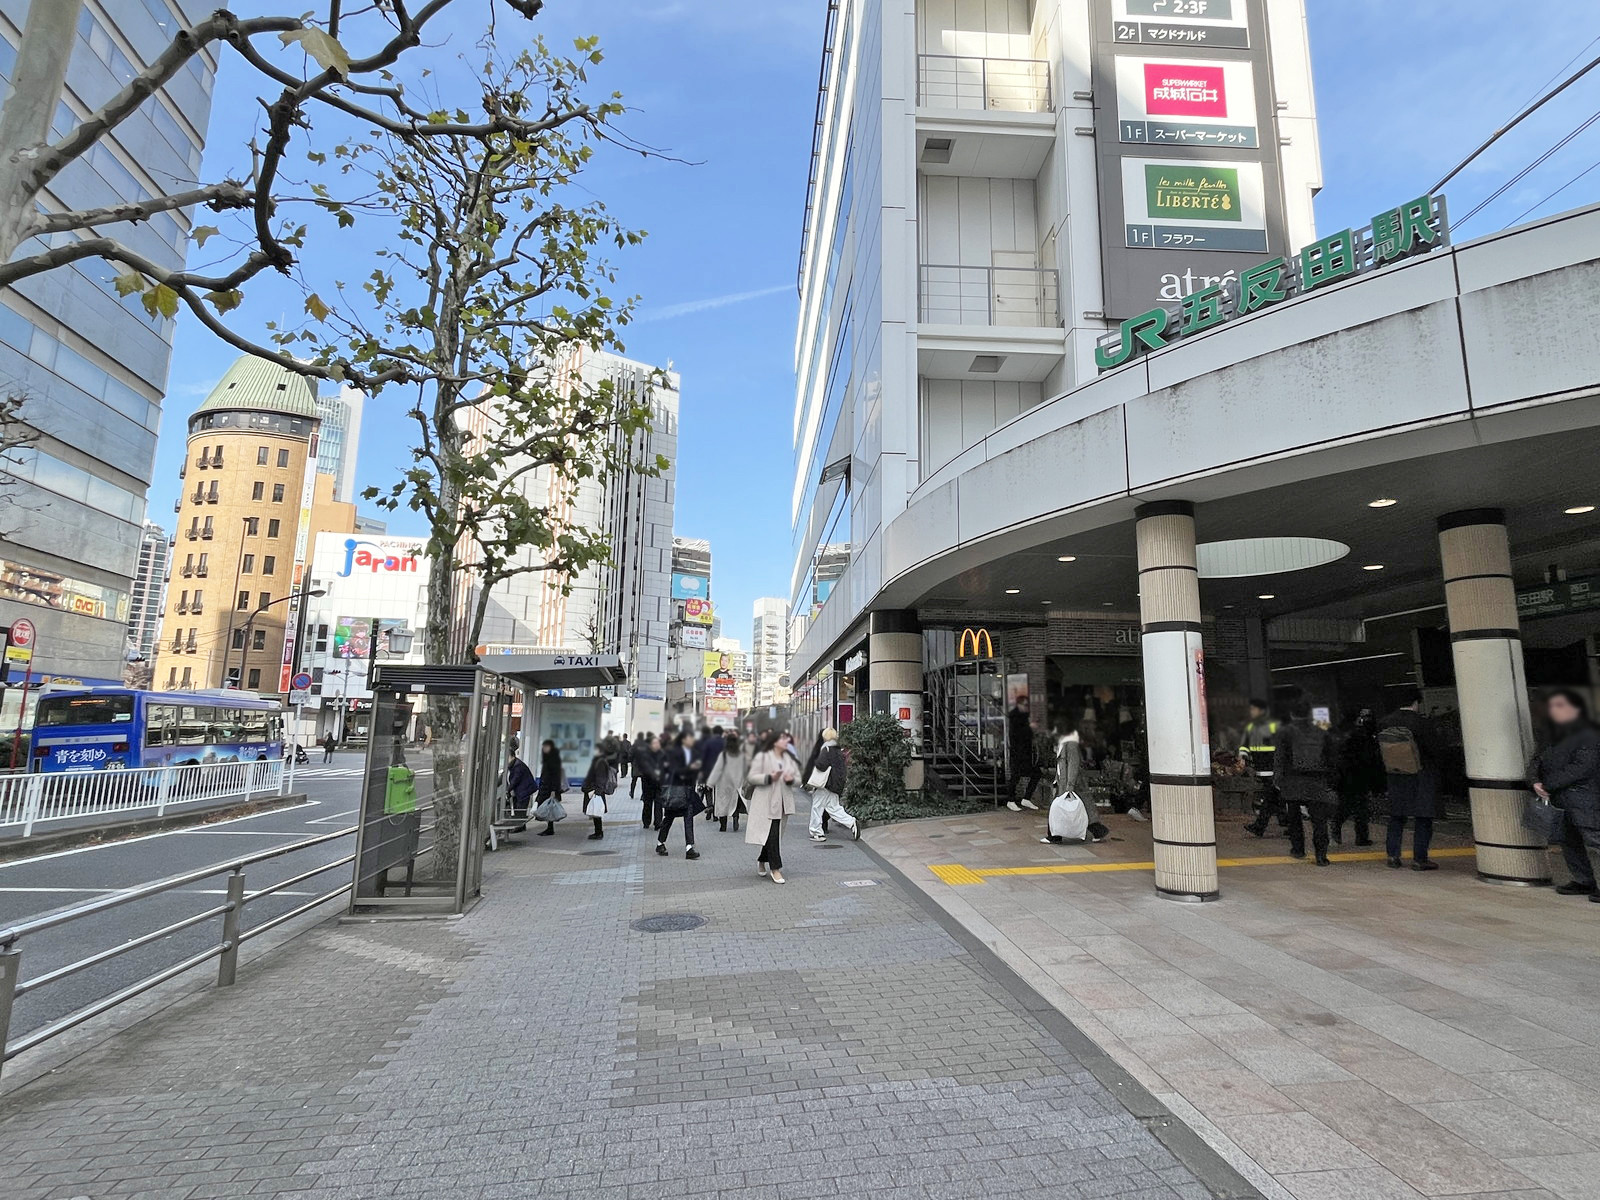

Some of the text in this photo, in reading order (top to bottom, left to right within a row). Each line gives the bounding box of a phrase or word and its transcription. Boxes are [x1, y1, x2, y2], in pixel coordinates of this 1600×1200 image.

[1118, 25, 1136, 39] 2F
[1148, 28, 1207, 41] マクドナルド
[1162, 79, 1207, 88] SUPERMARKET
[1153, 87, 1218, 102] 成城石井
[1126, 125, 1142, 139] 1F
[1155, 128, 1246, 143] スーパーマーケット
[1157, 190, 1220, 209] LIBERTÉ
[1133, 229, 1149, 243] 1F
[1162, 234, 1206, 244] フラワー
[337, 538, 417, 577] jaran
[567, 656, 599, 666] TAXI
[55, 748, 107, 764] 青を刻め
